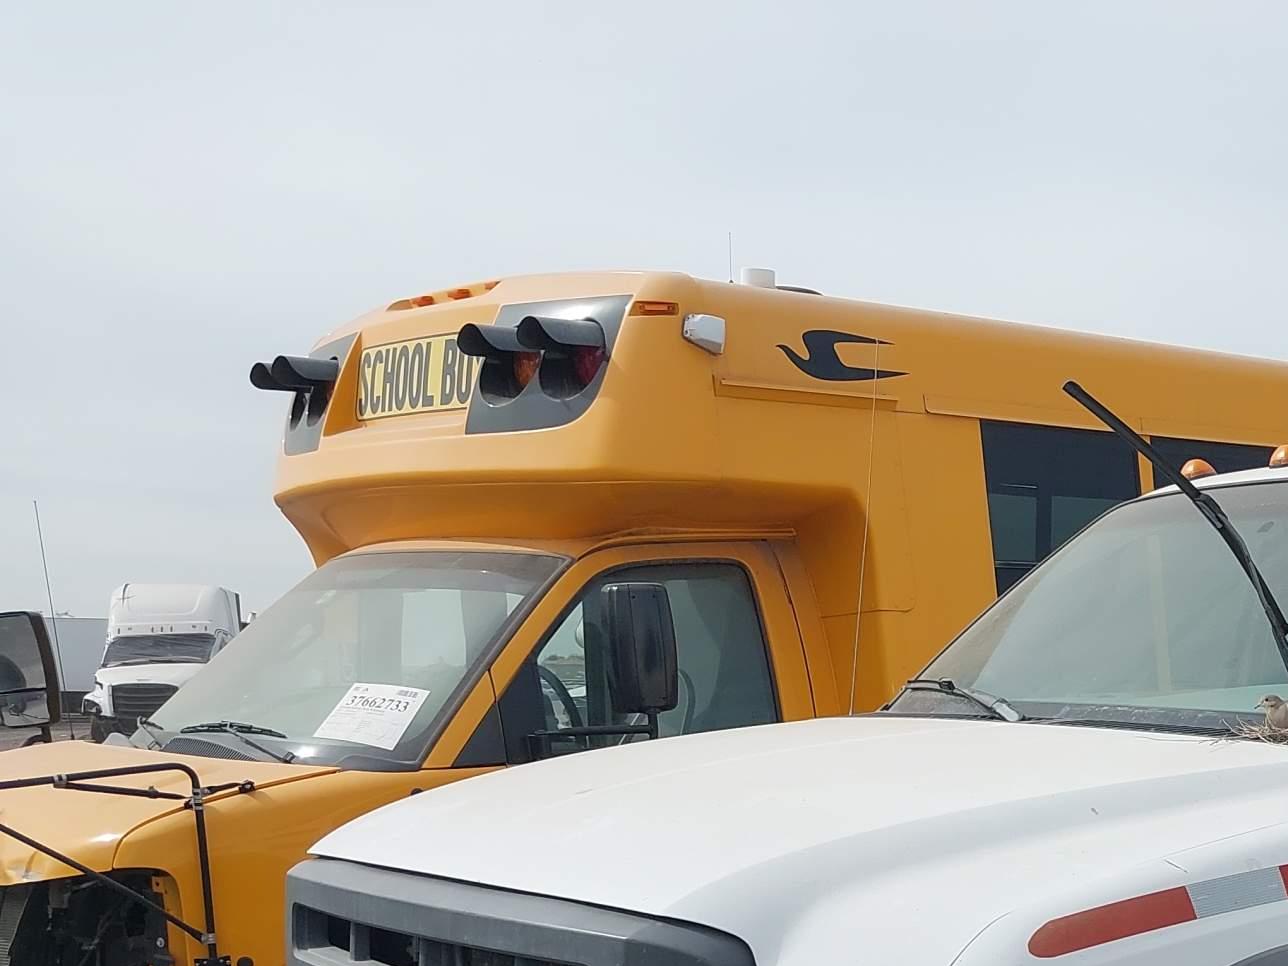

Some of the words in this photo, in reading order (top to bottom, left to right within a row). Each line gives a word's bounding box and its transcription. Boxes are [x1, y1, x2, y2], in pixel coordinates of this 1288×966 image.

[359, 341, 434, 416] SCHOOL
[440, 339, 477, 405] BU
[346, 695, 410, 712] 37662733
